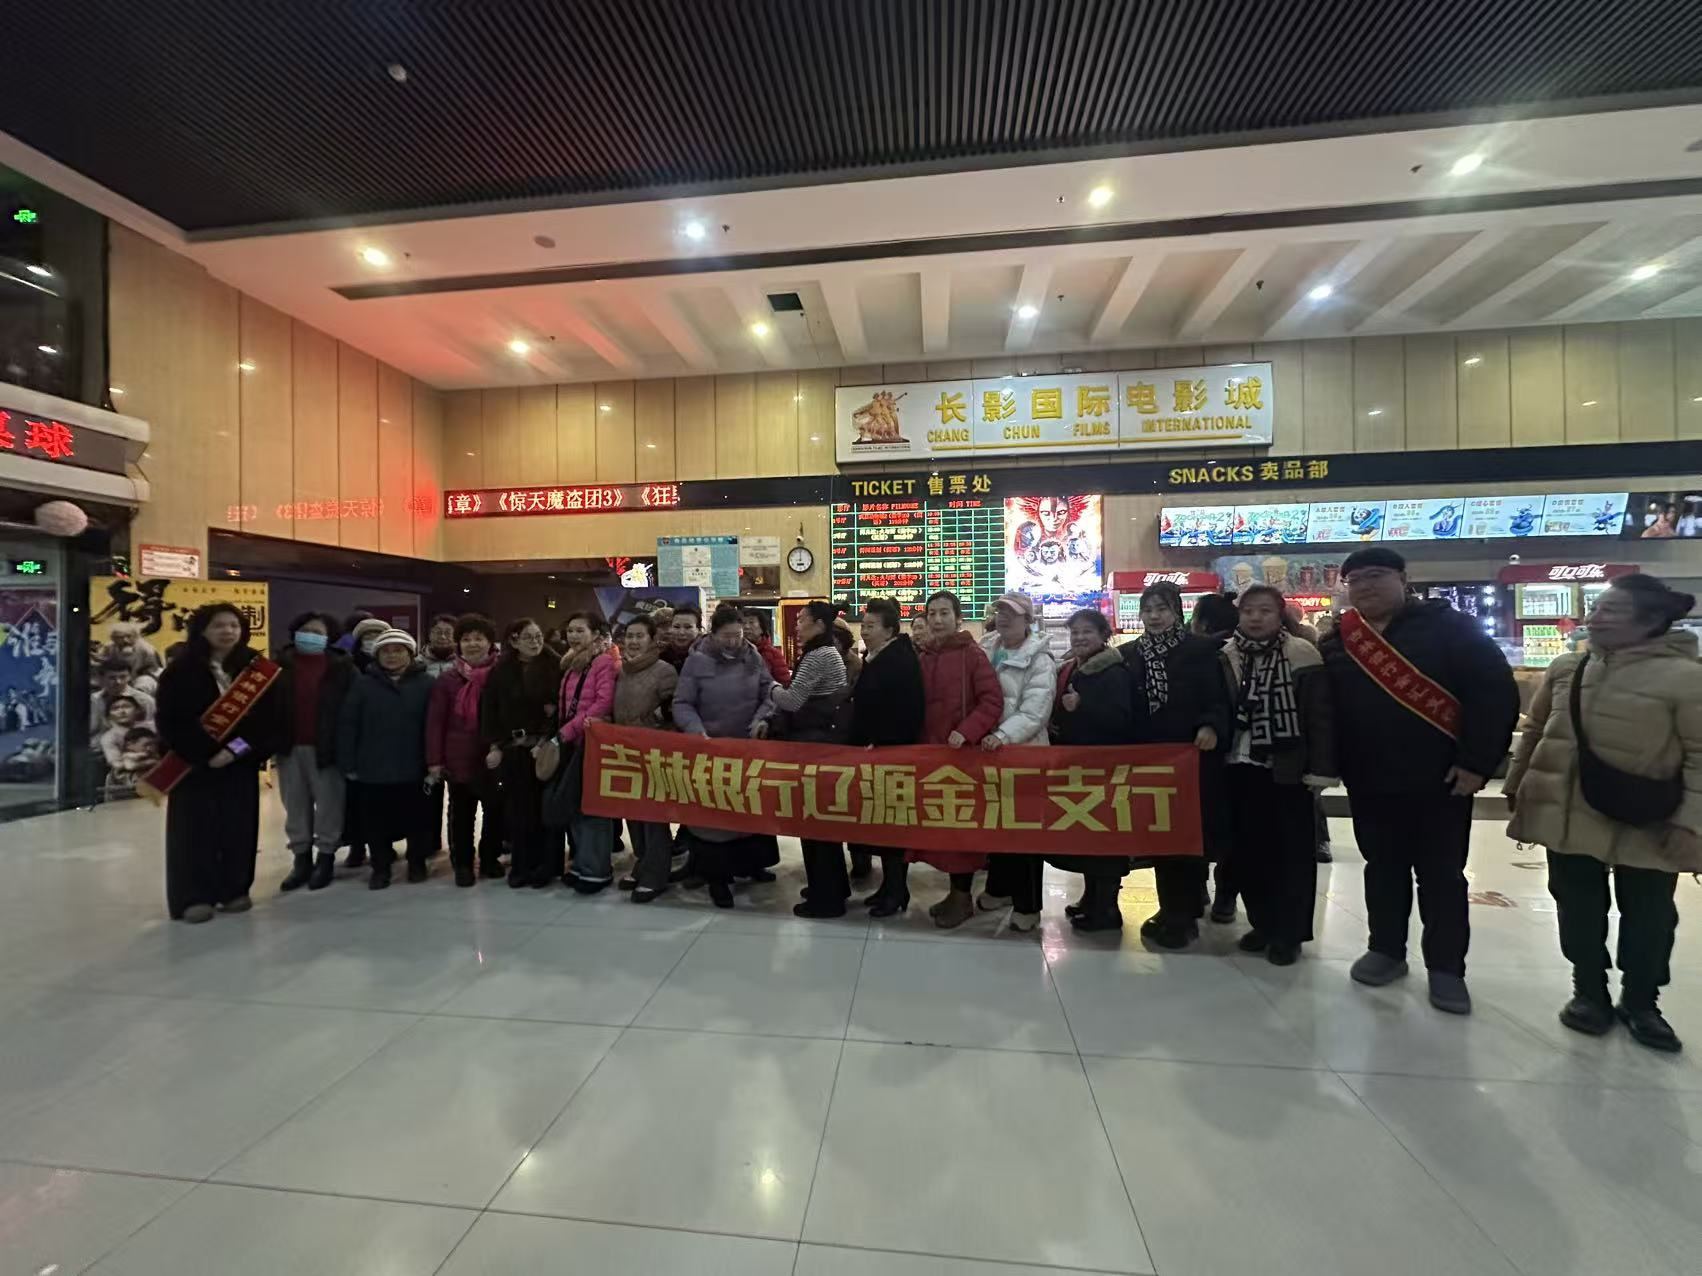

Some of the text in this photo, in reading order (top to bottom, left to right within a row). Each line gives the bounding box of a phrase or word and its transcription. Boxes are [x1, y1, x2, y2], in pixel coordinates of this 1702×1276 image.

[935, 376, 1265, 425] 长影国际电影城
[926, 416, 1252, 443] CHANG CHUN FILMS INTERNATIONAL
[1168, 460, 1329, 484] SNACKS 卖品部
[851, 474, 992, 496] TICKET 售票处
[498, 488, 623, 513] 《惊天魔盗团3》
[1143, 572, 1191, 587] 可口可乐
[1548, 564, 1607, 580] 可口可乐
[600, 744, 1177, 832] 吉林银行辽源金汇支行
